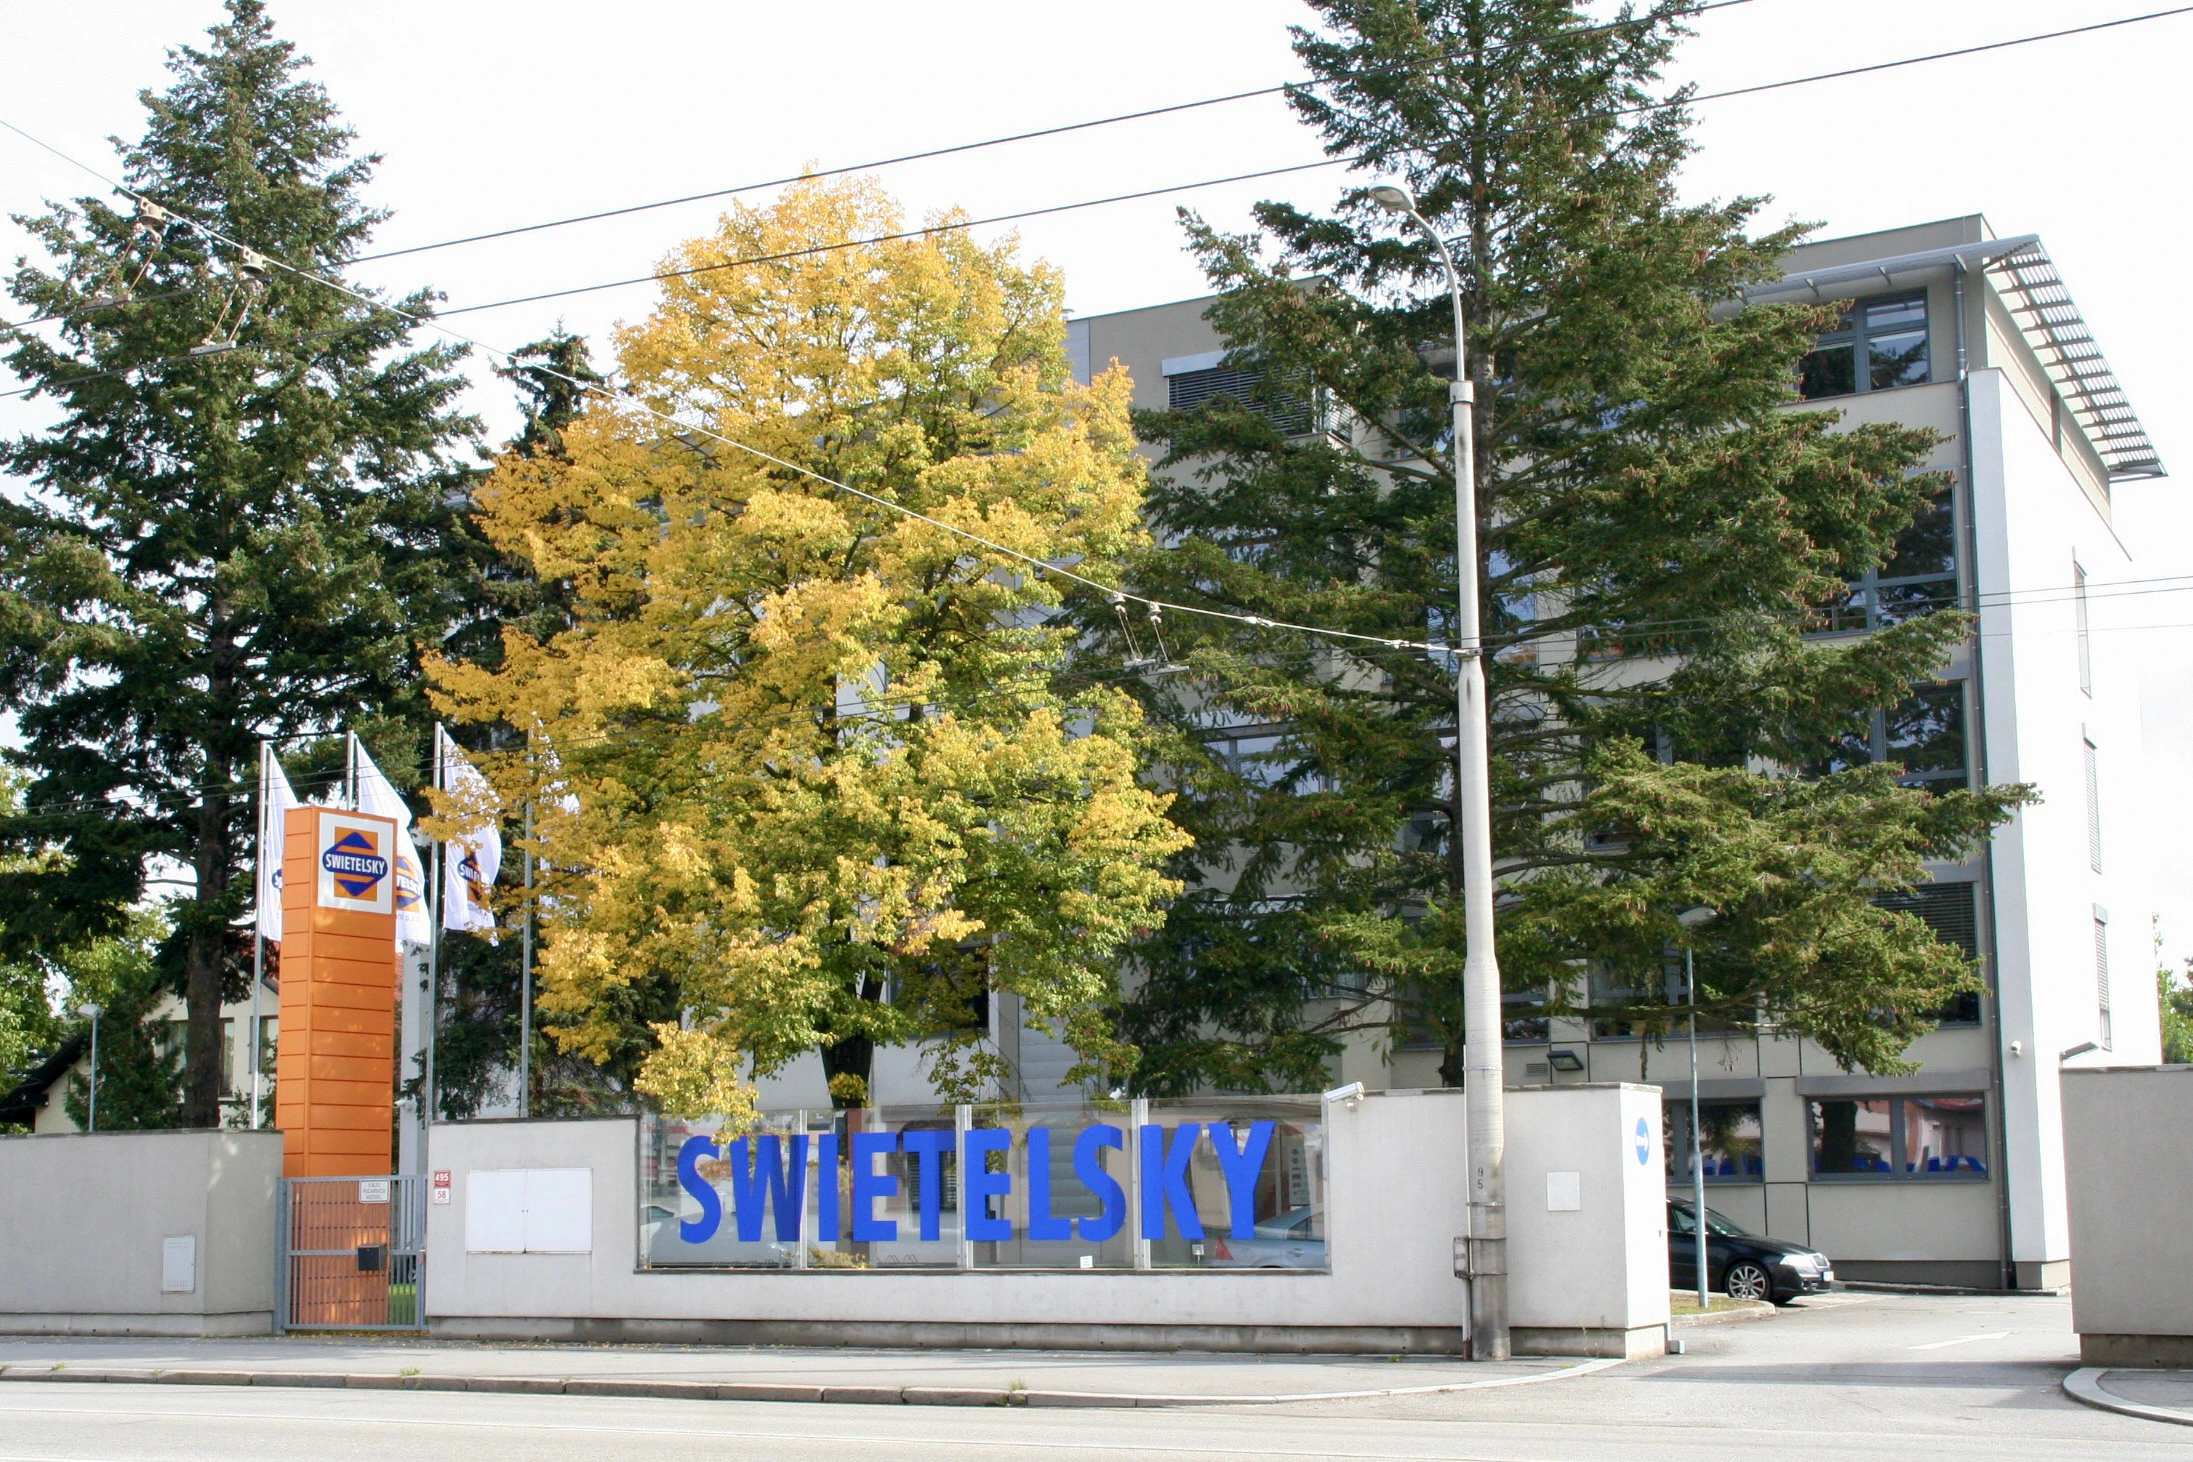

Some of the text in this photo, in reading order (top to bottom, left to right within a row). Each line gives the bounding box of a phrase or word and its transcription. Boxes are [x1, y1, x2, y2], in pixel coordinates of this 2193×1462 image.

[325, 853, 385, 875] SWIETELSKY
[435, 1172, 449, 1182] 495
[677, 1120, 1276, 1244] SWIETELSKY
[437, 1190, 447, 1199] 58
